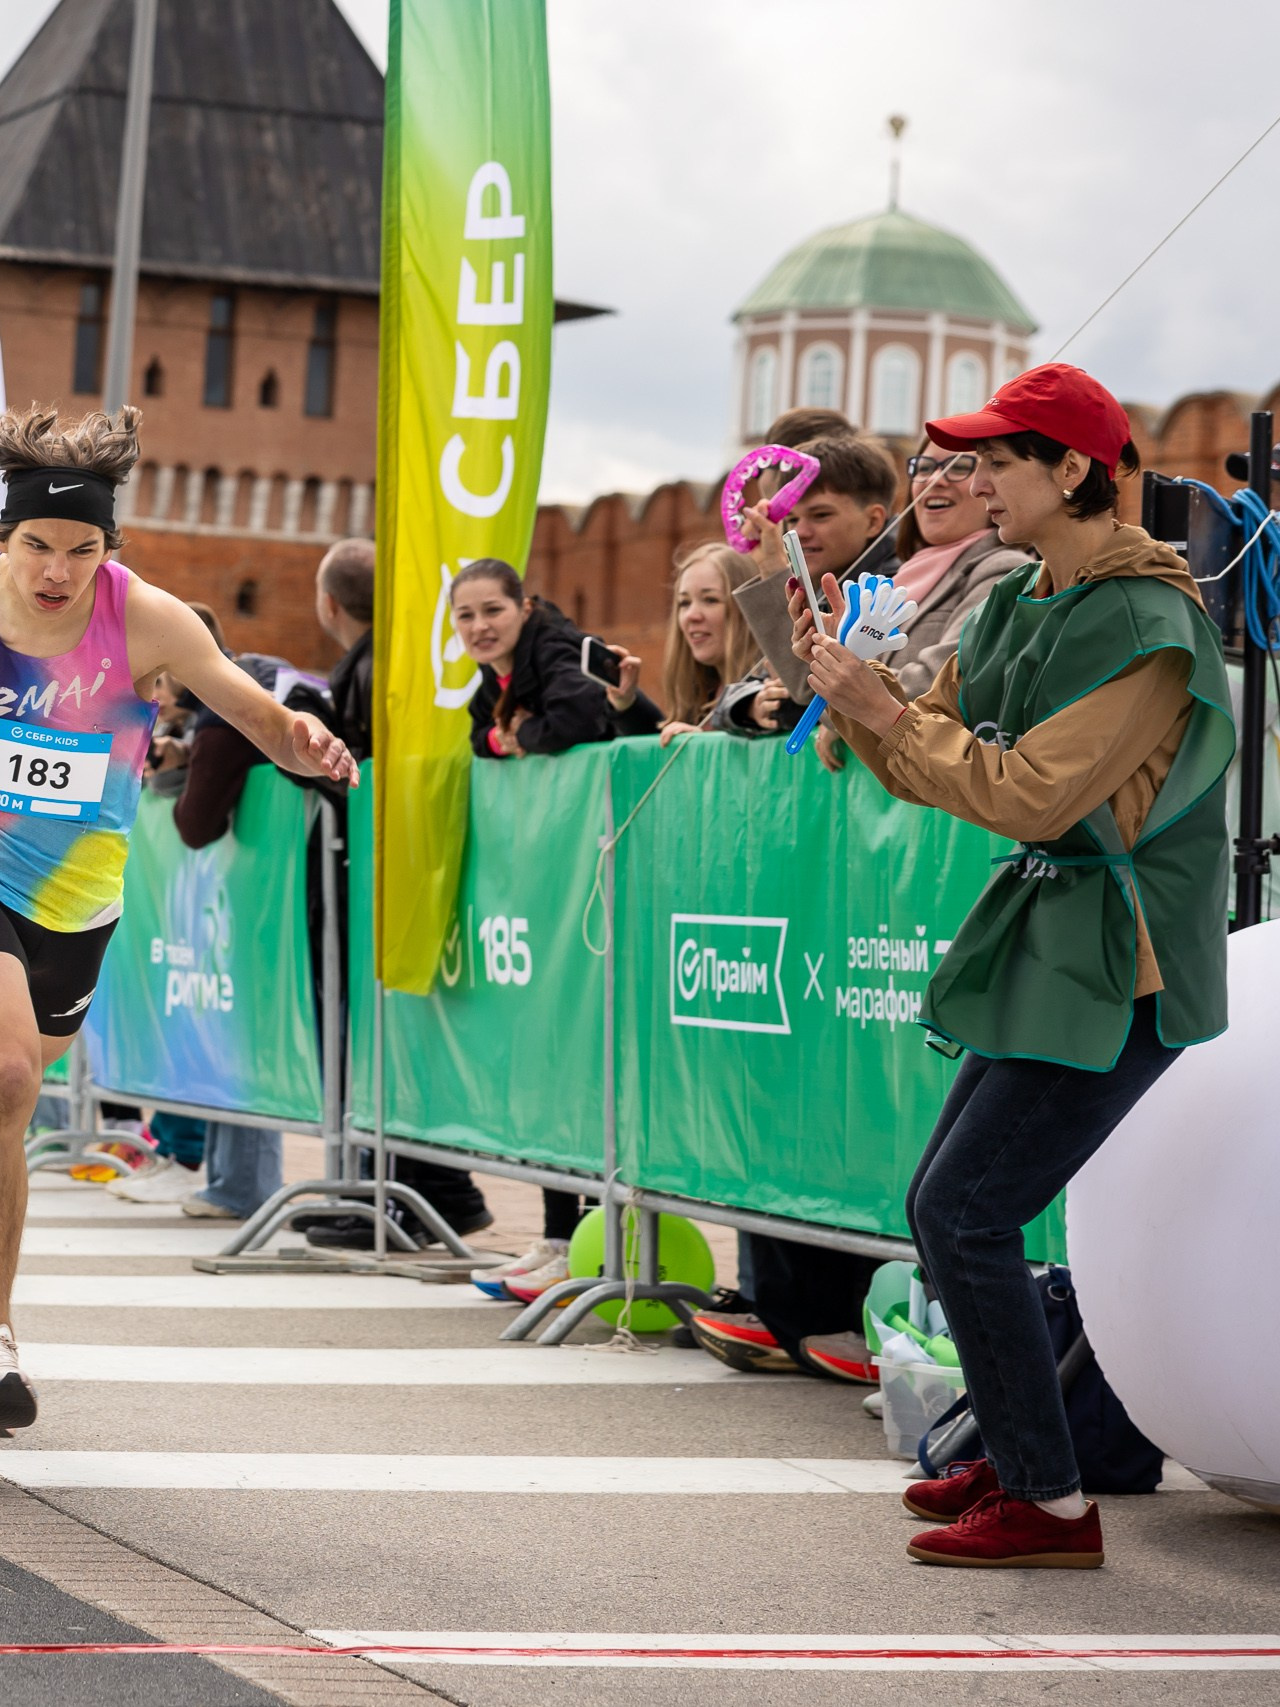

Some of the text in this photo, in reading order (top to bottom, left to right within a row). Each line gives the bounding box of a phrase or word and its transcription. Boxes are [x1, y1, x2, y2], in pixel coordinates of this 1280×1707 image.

[438, 160, 526, 519] СБЕР
[866, 627, 885, 641] ПСБ
[25, 730, 79, 747] СБЕР KIDS
[8, 754, 71, 790] 183
[478, 915, 532, 986] 185
[702, 946, 768, 1003] Прайм
[847, 923, 929, 973] зелёный
[835, 974, 922, 1032] марафон
